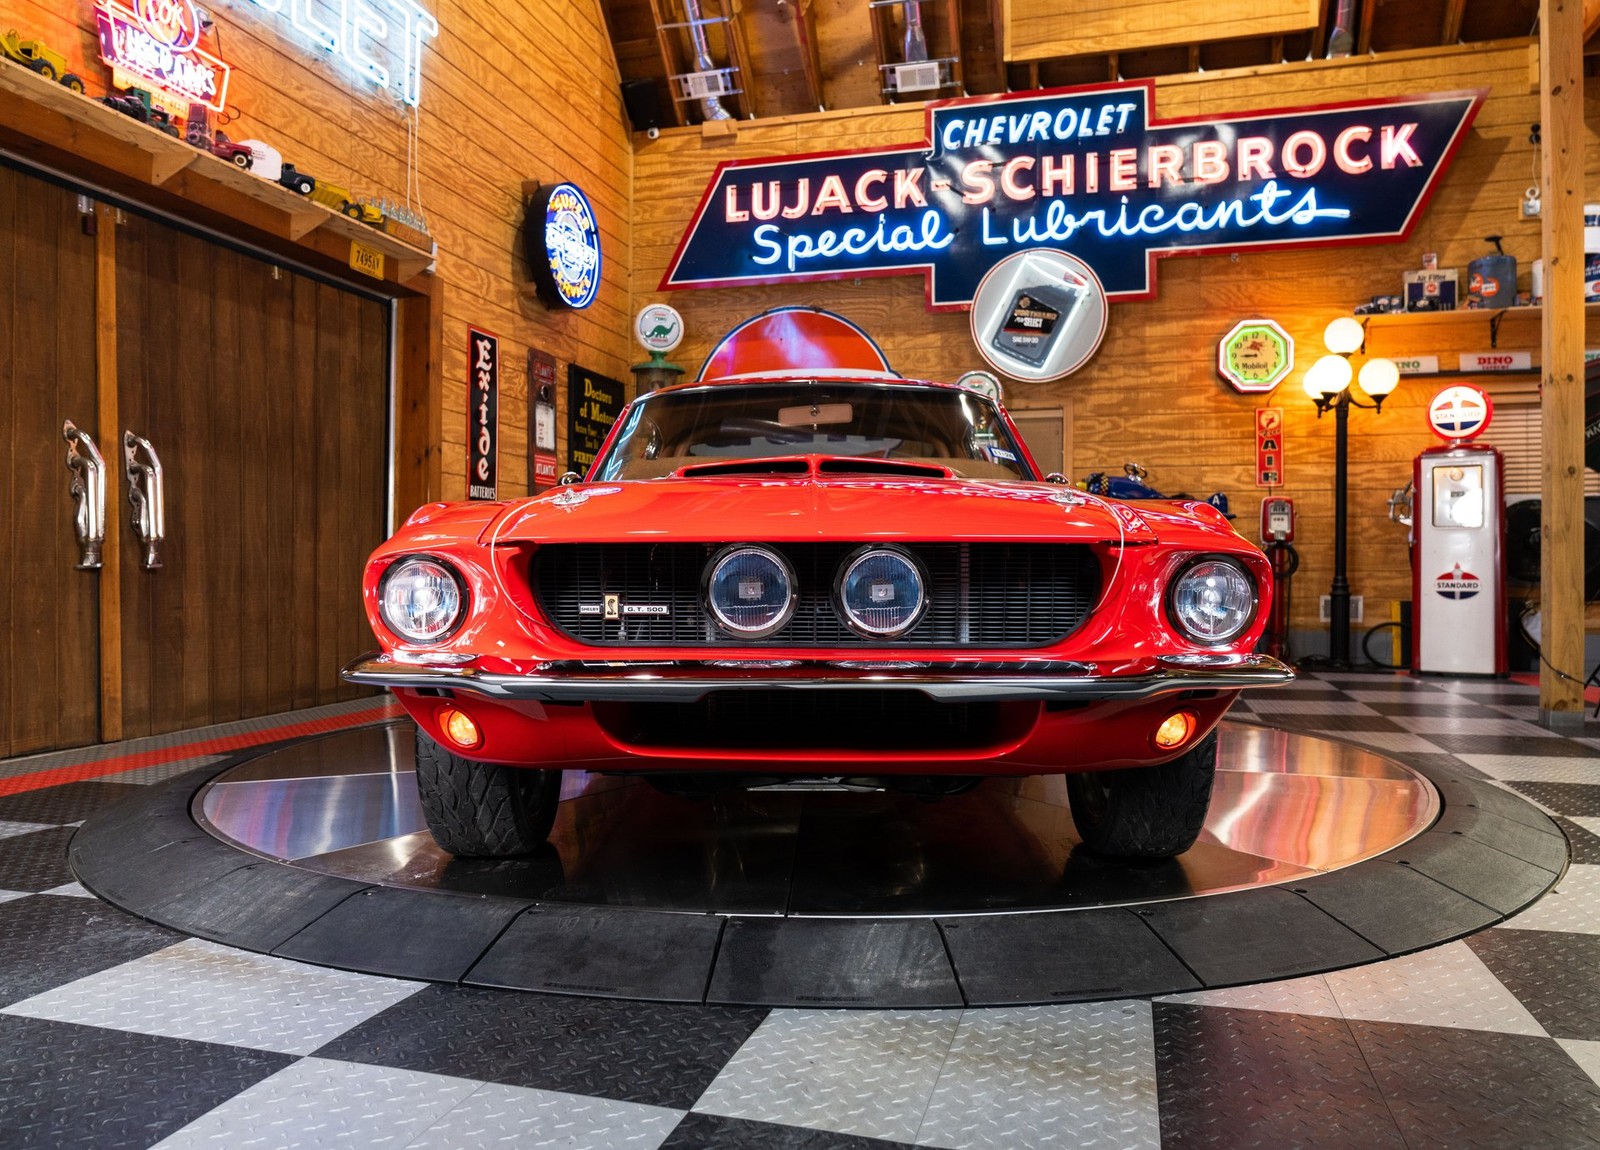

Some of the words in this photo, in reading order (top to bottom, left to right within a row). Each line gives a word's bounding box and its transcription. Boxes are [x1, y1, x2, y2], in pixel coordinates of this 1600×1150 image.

[943, 103, 1137, 151] CHEVROLET
[725, 122, 1423, 222] LUJACK-SCHIERBROCK
[752, 210, 955, 272] Special
[983, 181, 1351, 245] Lubricants
[1417, 274, 1427, 282] Air
[1428, 273, 1446, 281] Filter
[1477, 356, 1513, 365] DINO
[584, 378, 612, 404] Doctors
[580, 402, 588, 417] of
[591, 401, 615, 425] Motors
[1434, 410, 1480, 420] STANARD
[1261, 439, 1279, 482] AIR
[535, 462, 556, 477] ATLANTIC
[470, 485, 496, 499] BATTERIES
[1212, 495, 1220, 505] A
[1437, 581, 1479, 589] STANDARD
